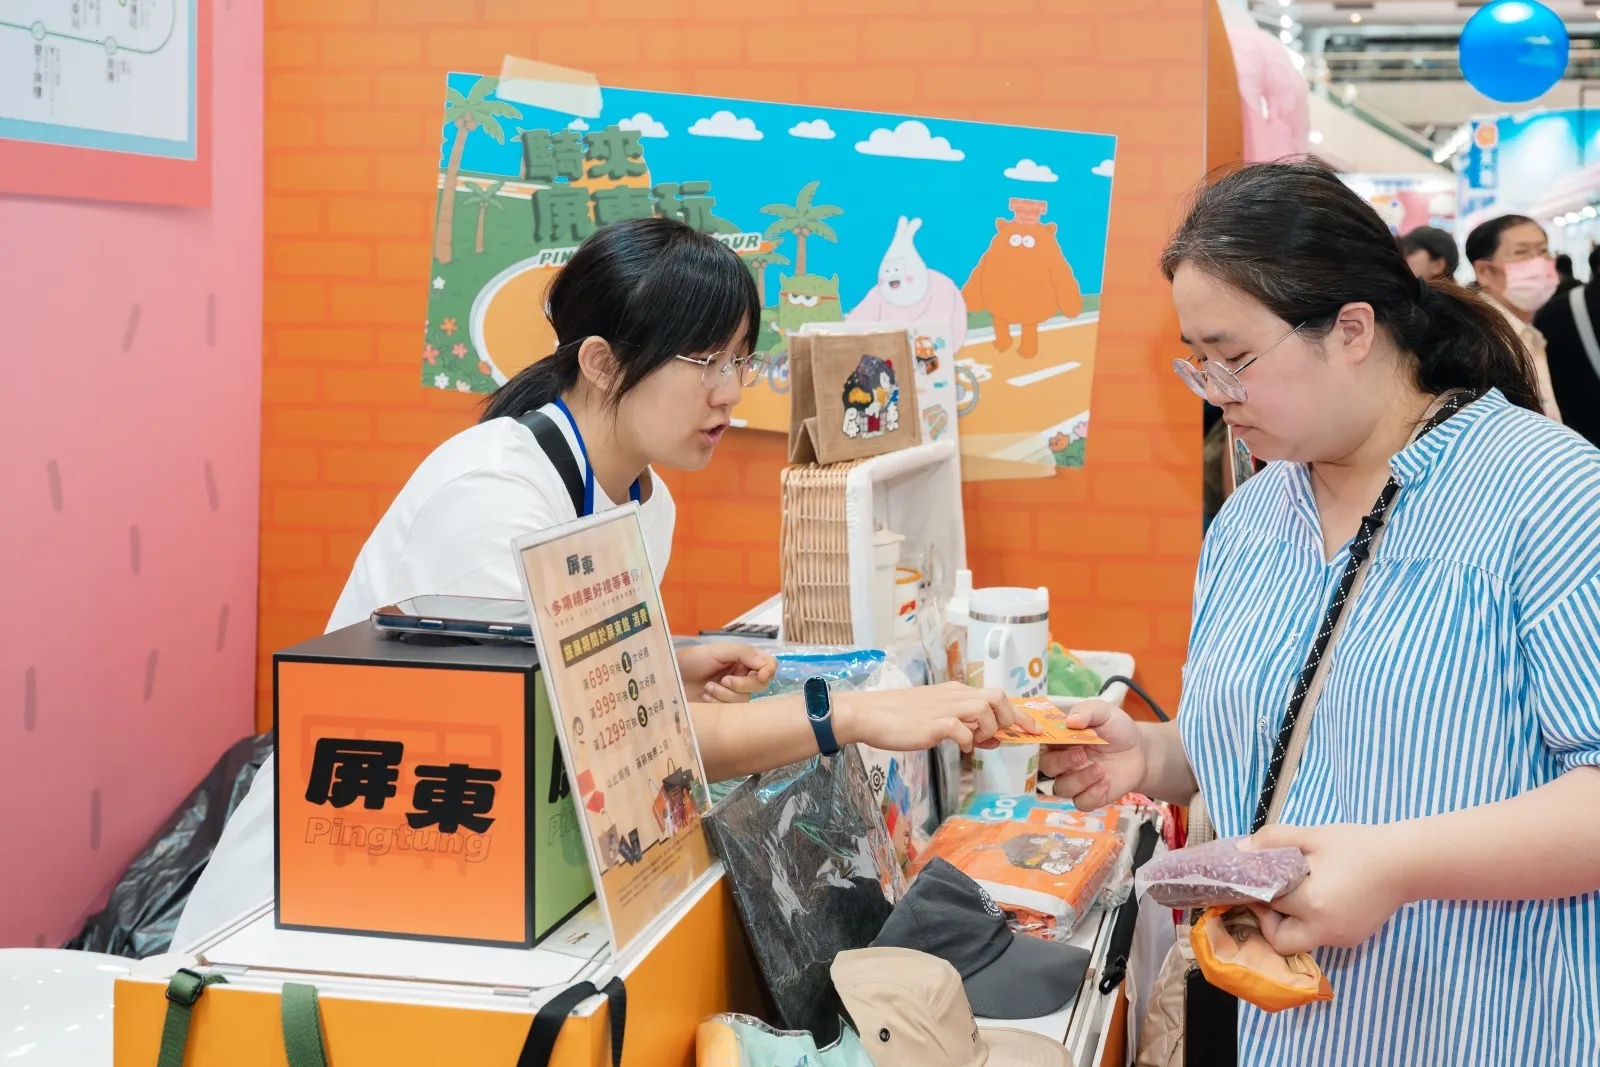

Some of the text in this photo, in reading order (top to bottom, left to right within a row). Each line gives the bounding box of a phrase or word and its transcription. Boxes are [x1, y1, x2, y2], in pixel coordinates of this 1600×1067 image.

[521, 125, 648, 183] 騎來
[720, 235, 759, 250] OUR
[566, 553, 595, 576] 屏東
[305, 738, 502, 834] 屏東
[305, 817, 493, 863] Pingtung
